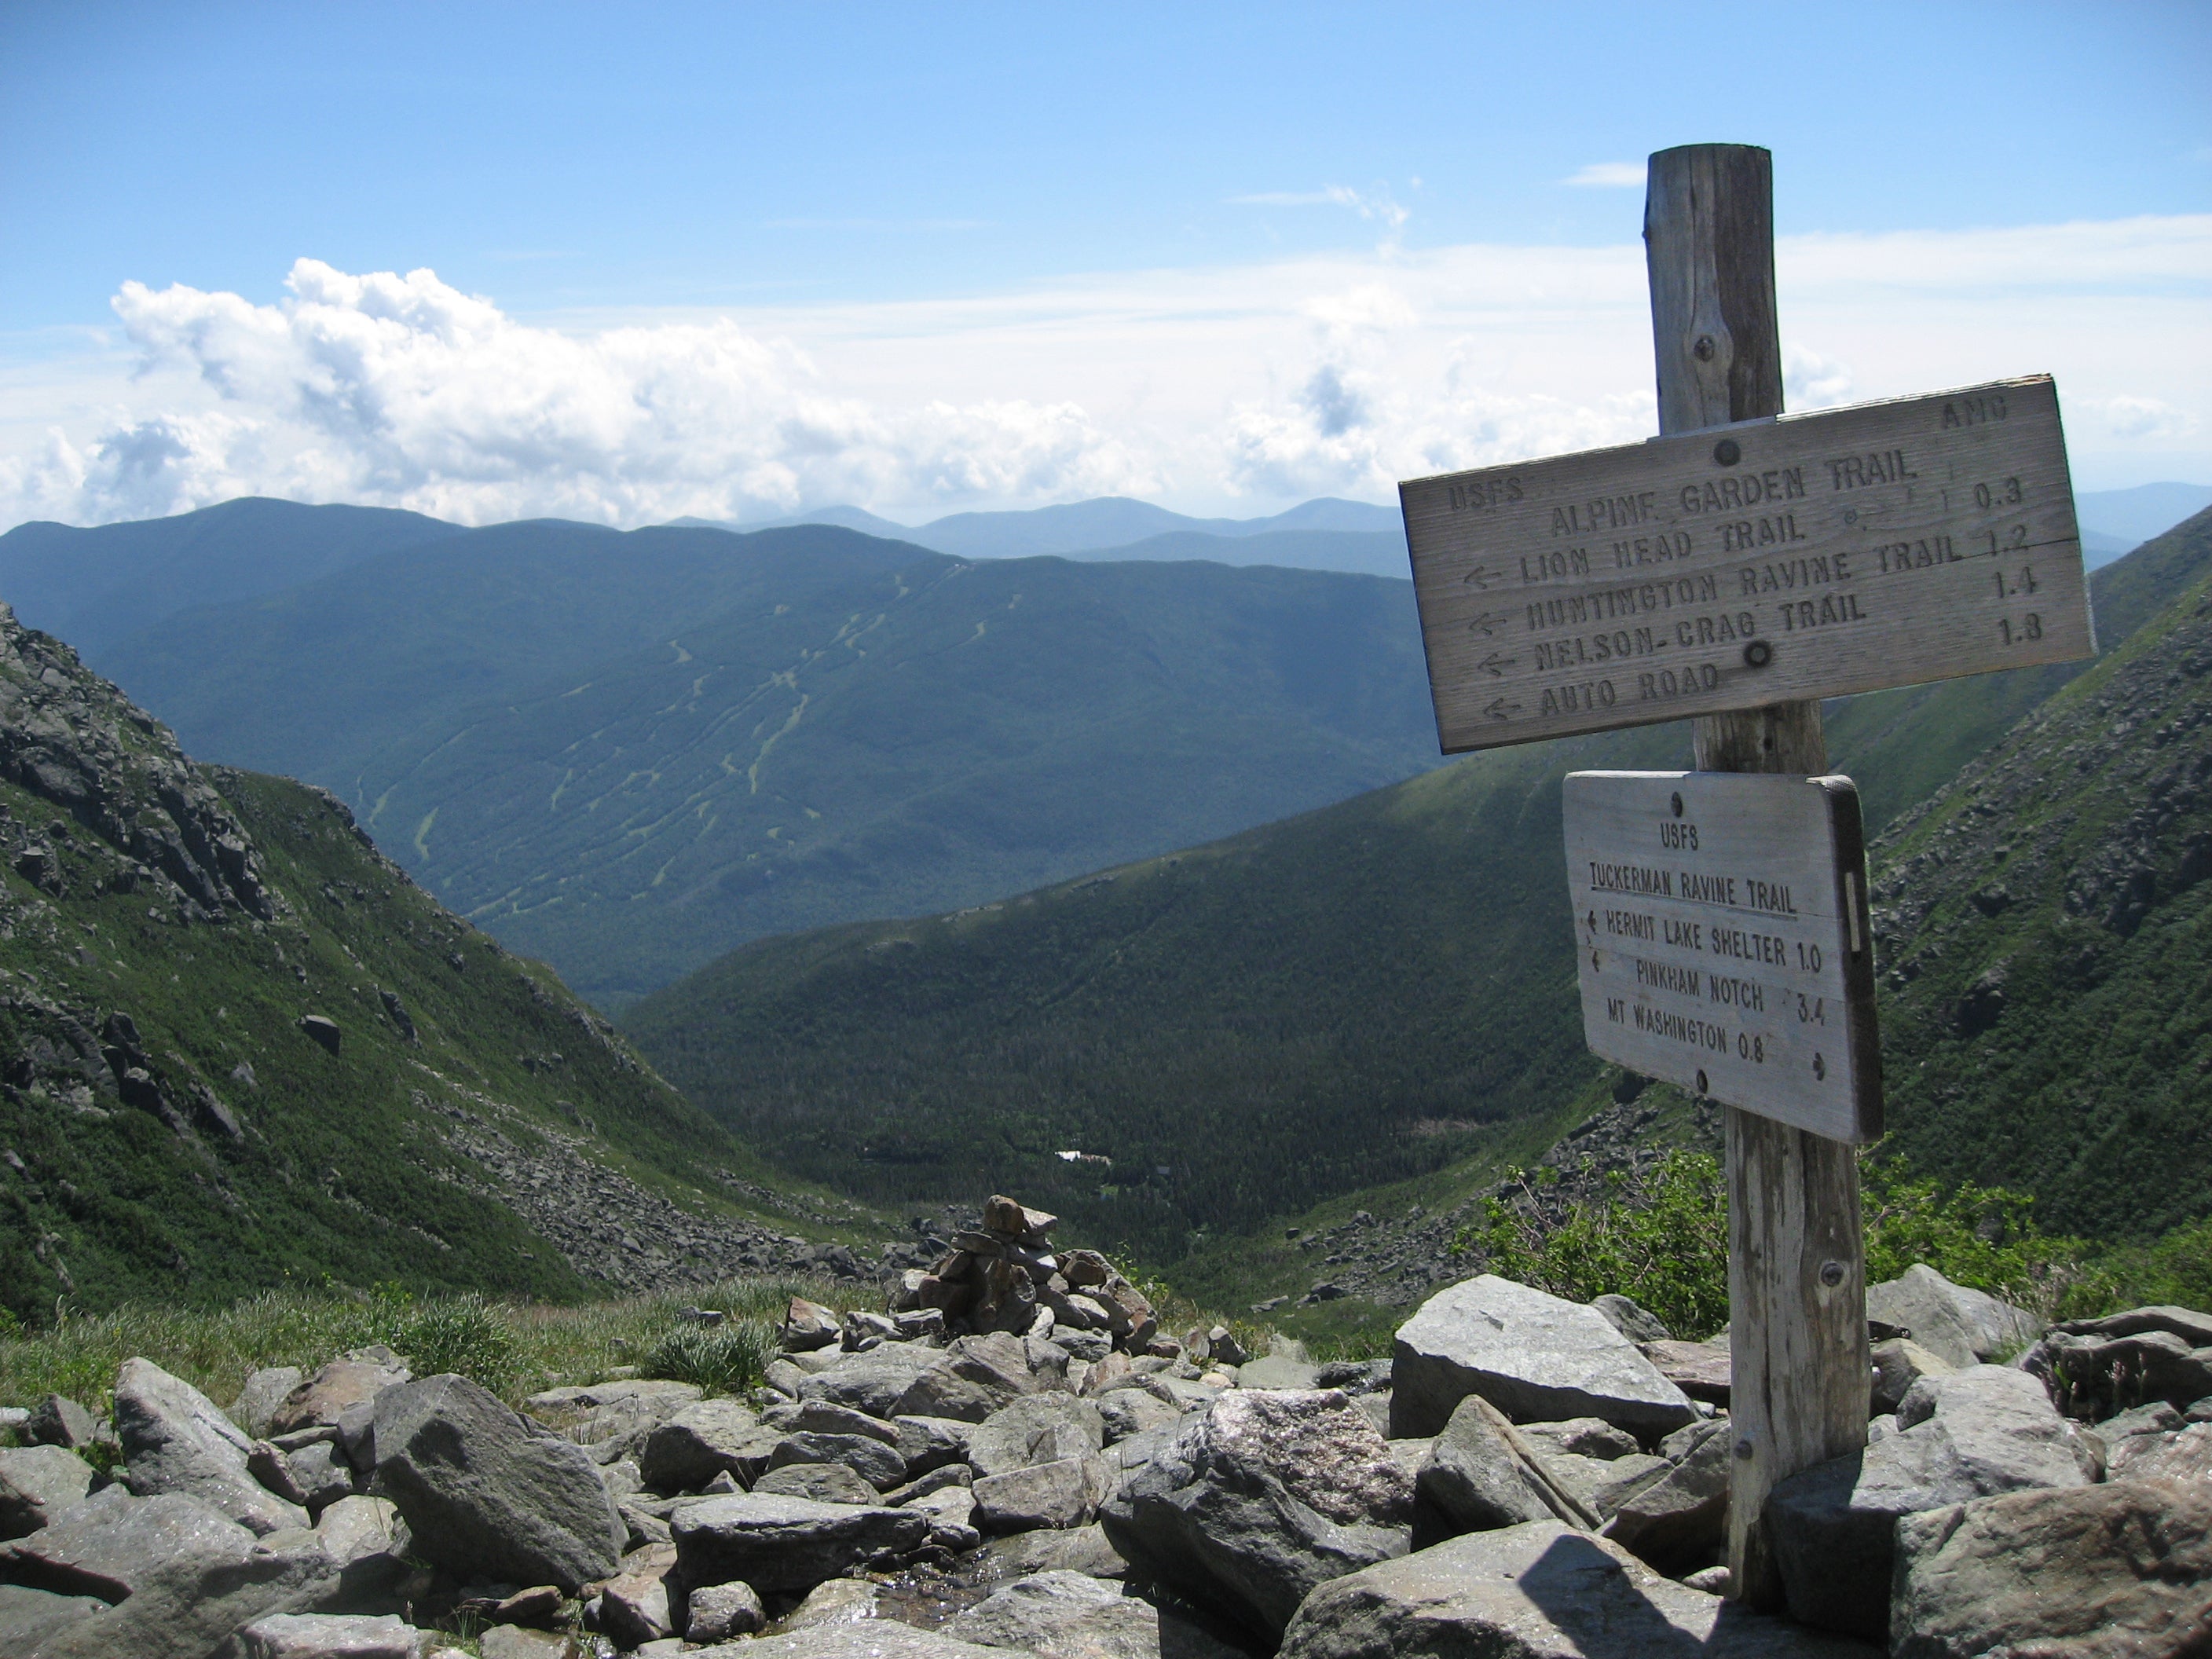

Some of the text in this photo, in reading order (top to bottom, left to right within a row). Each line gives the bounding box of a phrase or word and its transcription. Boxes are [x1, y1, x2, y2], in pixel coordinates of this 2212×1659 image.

[1448, 477, 1524, 512] USFS
[1550, 449, 1917, 539] ALPINE GARDEN TRAIL
[1520, 476, 2023, 584] LION HEAD TRAIL 0.3
[1526, 524, 2030, 629] HUNTINGTON RAVINE TRAIL 1.2
[1778, 594, 1866, 631] TRAIL
[1994, 566, 2038, 599] 1.4
[1540, 679, 1617, 717] AUTO
[1637, 663, 1719, 701] ROAD
[1660, 822, 1699, 851] USFS
[1589, 861, 1797, 914] TUCKERMAN RAVINE TRAIL
[1606, 909, 1822, 973] HERMIT LAKE SHELTER 1.0
[1636, 958, 1826, 1027] PINKHAM NOTCH 3.4
[1607, 997, 1764, 1064] MT WASHINGTON 0.8
